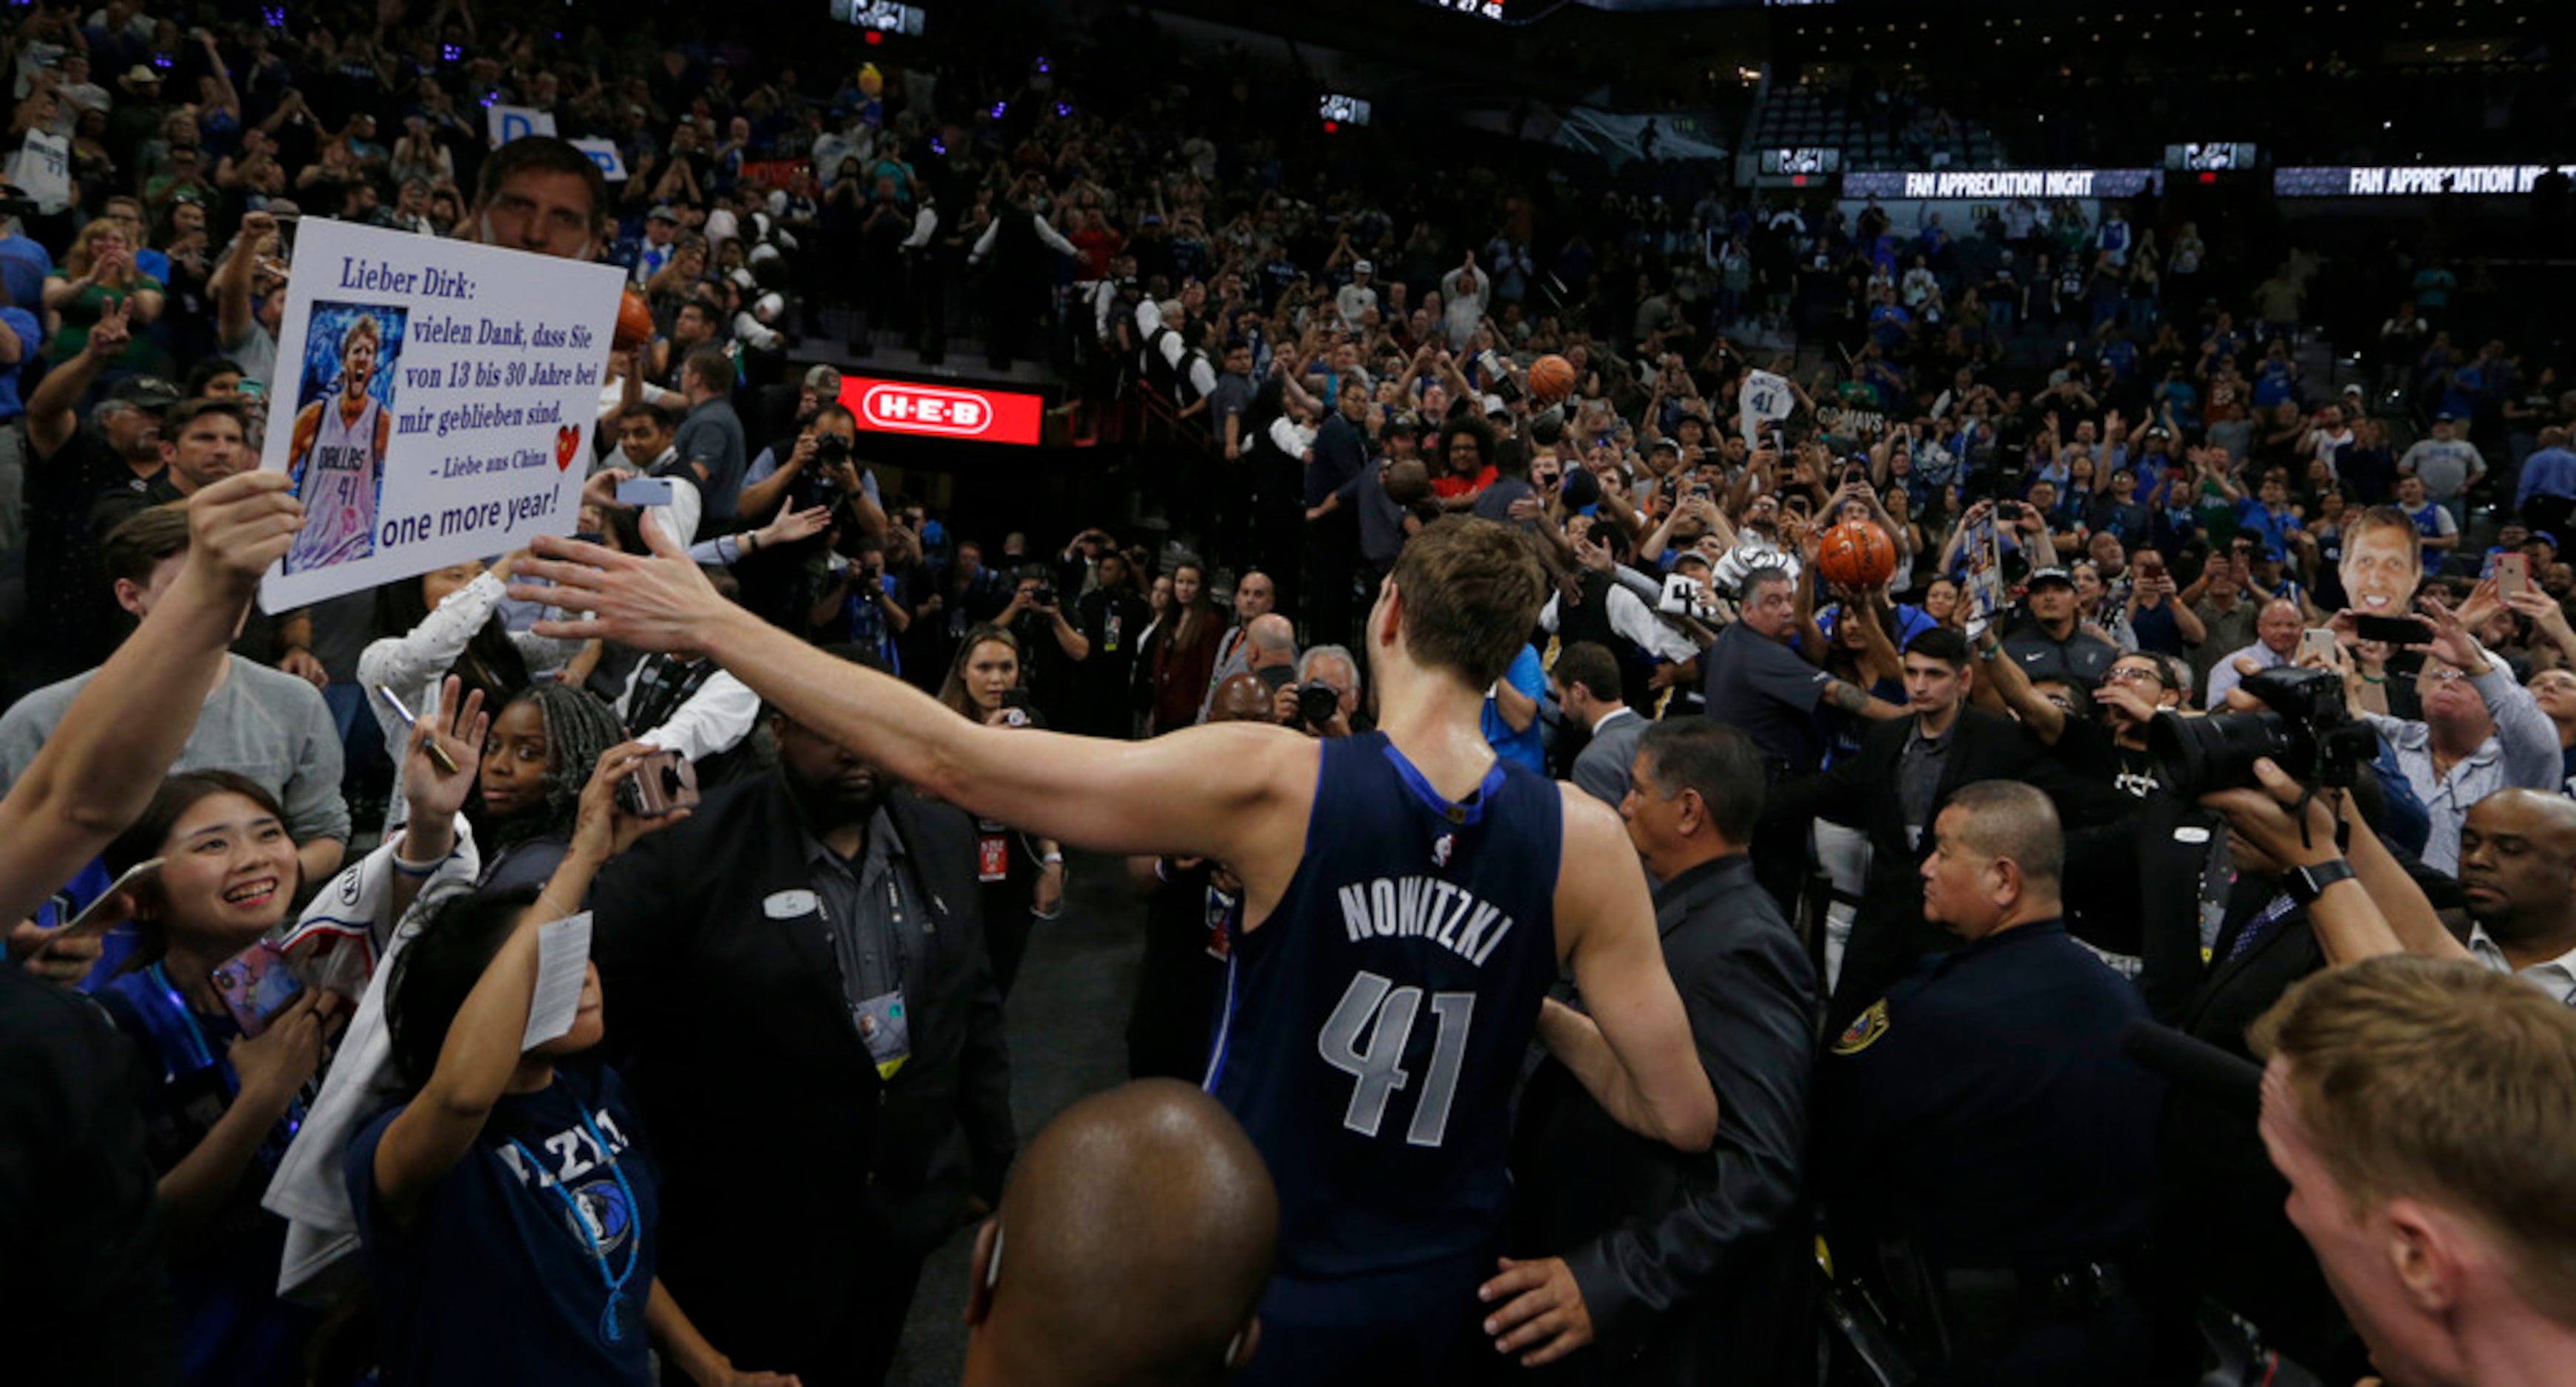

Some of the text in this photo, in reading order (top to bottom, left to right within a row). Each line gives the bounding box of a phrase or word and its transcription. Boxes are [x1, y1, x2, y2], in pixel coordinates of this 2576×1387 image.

[1904, 171, 2094, 197] FAN APPRECIATION NIGHT
[2348, 167, 2386, 194] FAN
[339, 257, 476, 299] Lieber Dirk:
[414, 315, 592, 349] vielen Dank, dass Sie
[406, 361, 598, 388] von 13 bis 30 Jahre bei
[397, 401, 562, 436] mir geblieben sind.
[1751, 391, 1774, 414] 41
[443, 457, 482, 479] Liebe
[486, 454, 510, 473] aus
[513, 449, 547, 470] China
[338, 476, 357, 505] 41
[383, 484, 561, 549] one more year!
[1338, 874, 1515, 968] NOWITZKI
[1317, 969, 1477, 1148] 41
